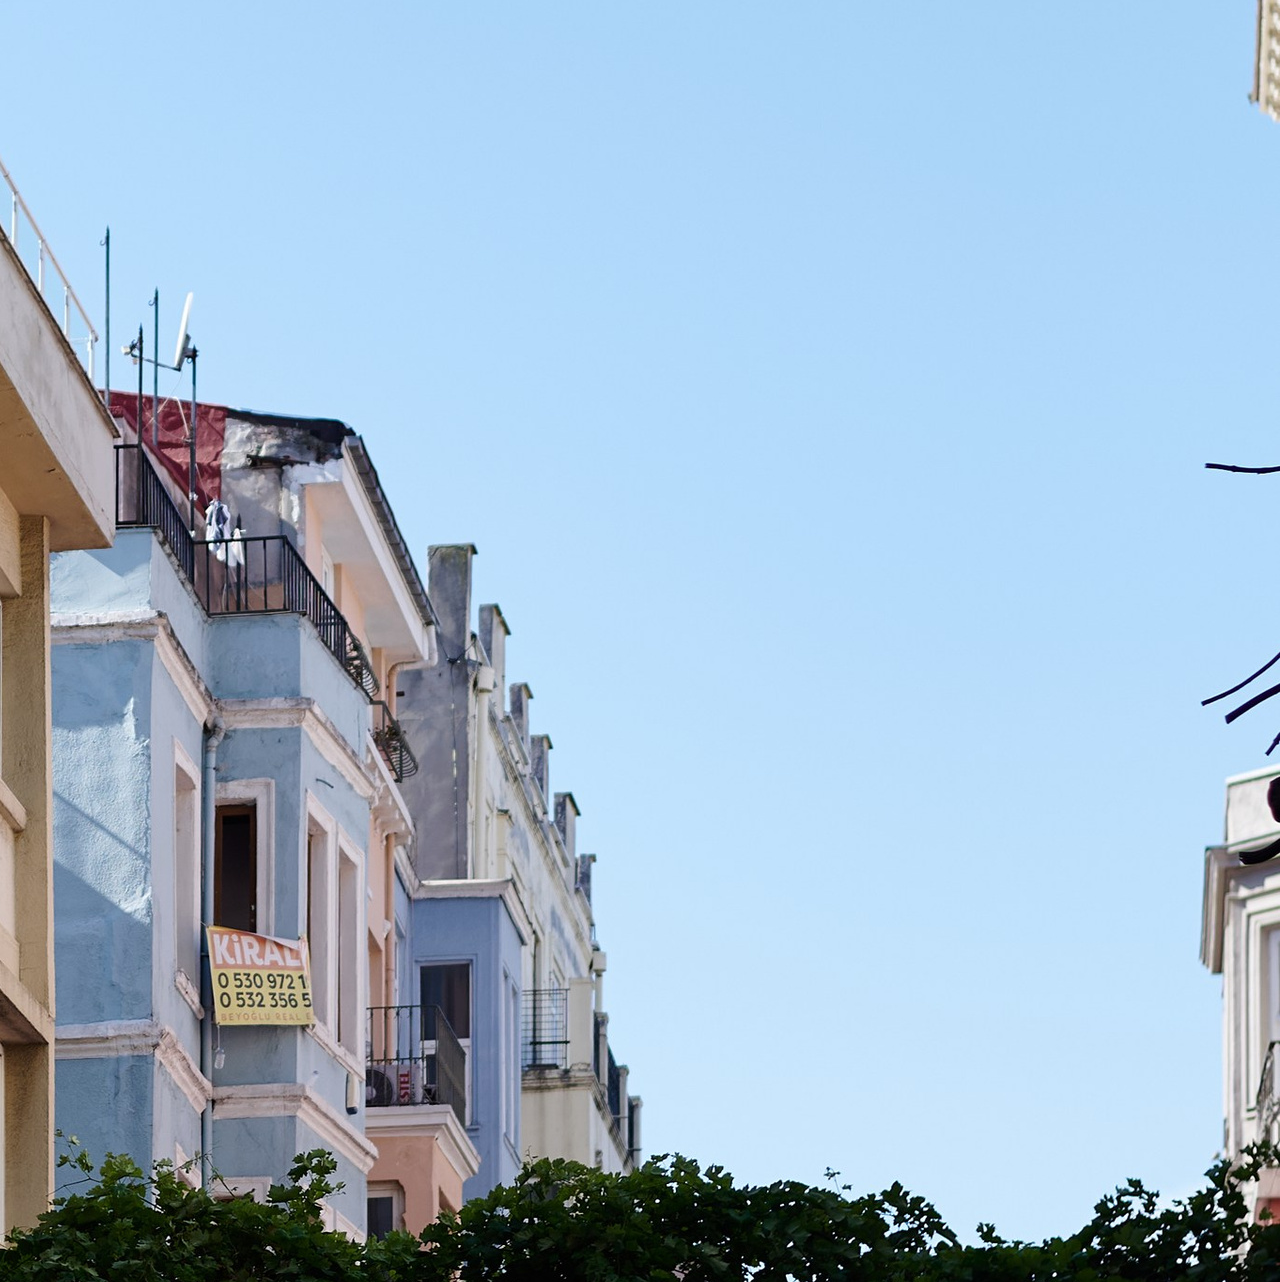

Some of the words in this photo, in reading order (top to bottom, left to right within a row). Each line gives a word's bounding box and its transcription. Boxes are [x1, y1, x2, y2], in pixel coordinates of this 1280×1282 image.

[218, 972, 229, 989] 0
[234, 972, 264, 989] 530
[267, 973, 296, 990] 972
[220, 992, 231, 1008] 0
[236, 992, 266, 1008] 532
[269, 992, 299, 1008] 356
[221, 1011, 271, 1022] BEYOĞLU
[275, 1012, 301, 1021] REAL
